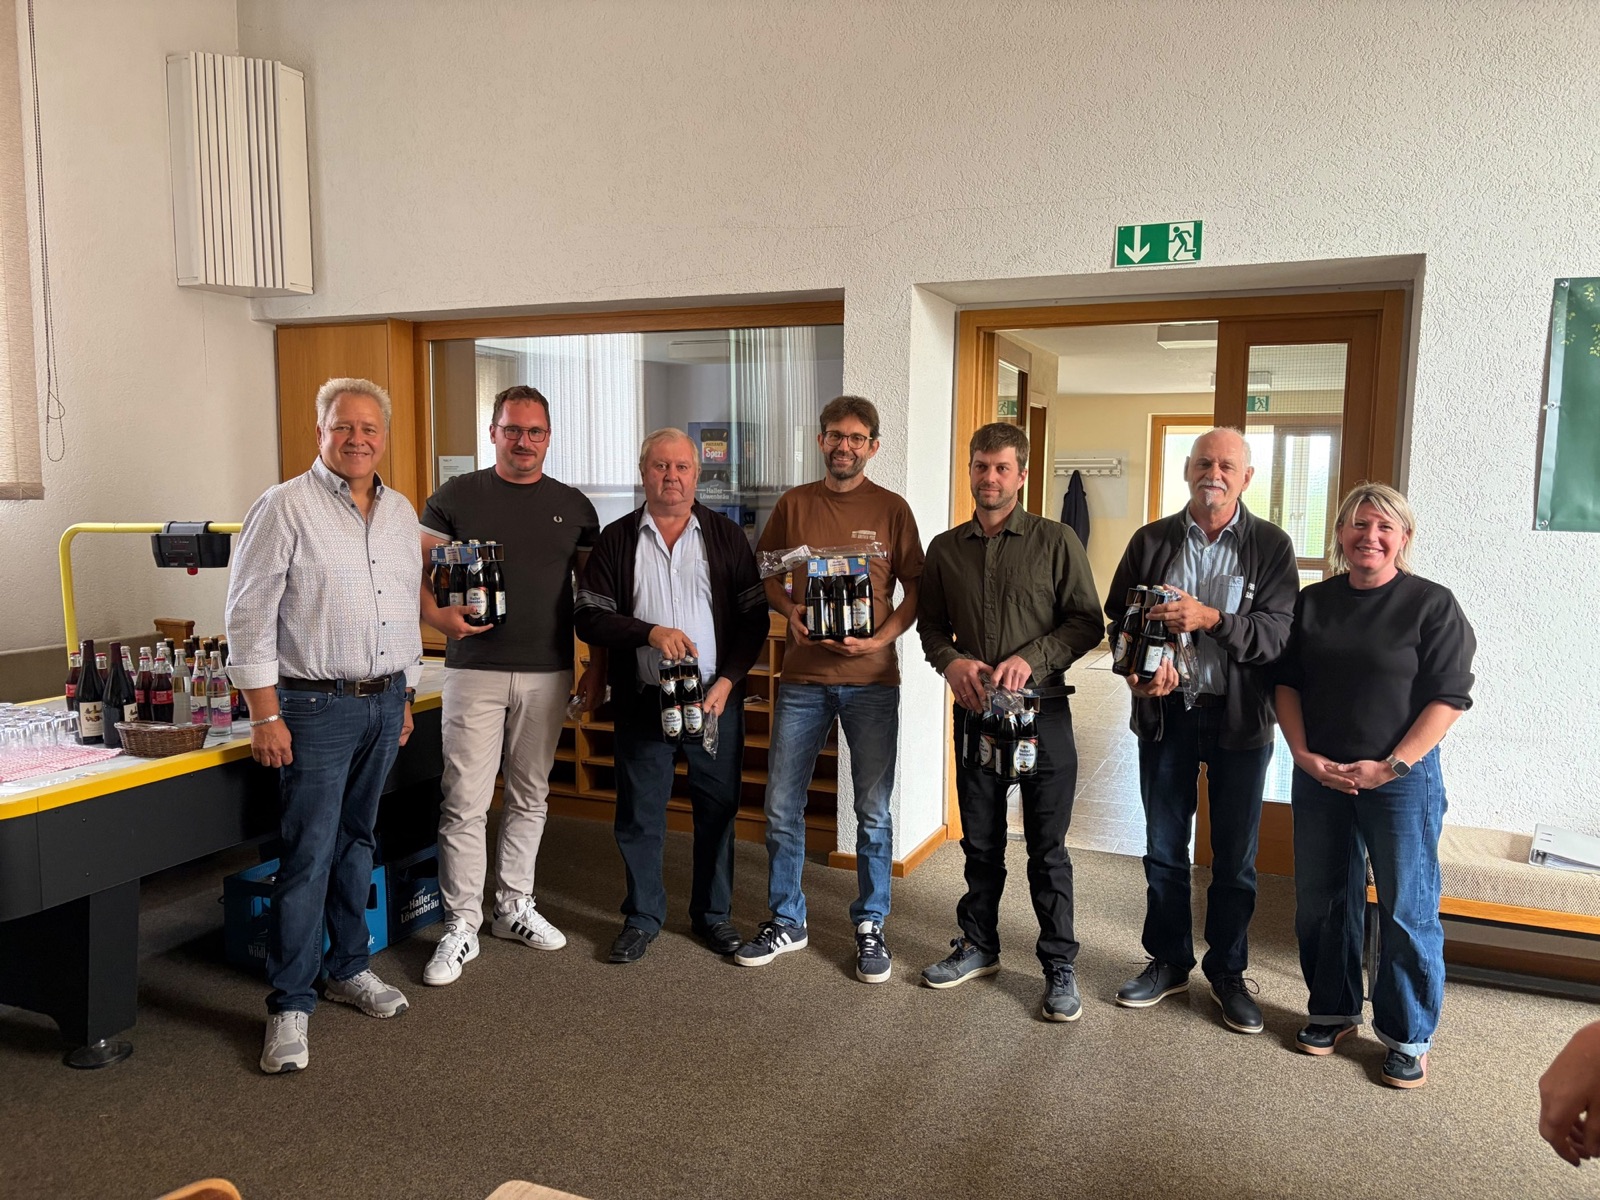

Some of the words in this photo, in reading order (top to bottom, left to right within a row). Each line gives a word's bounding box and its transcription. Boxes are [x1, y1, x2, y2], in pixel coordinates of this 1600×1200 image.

[705, 447, 724, 459] Spezi
[409, 893, 431, 911] Haller
[400, 899, 440, 924] Löwenbräu
